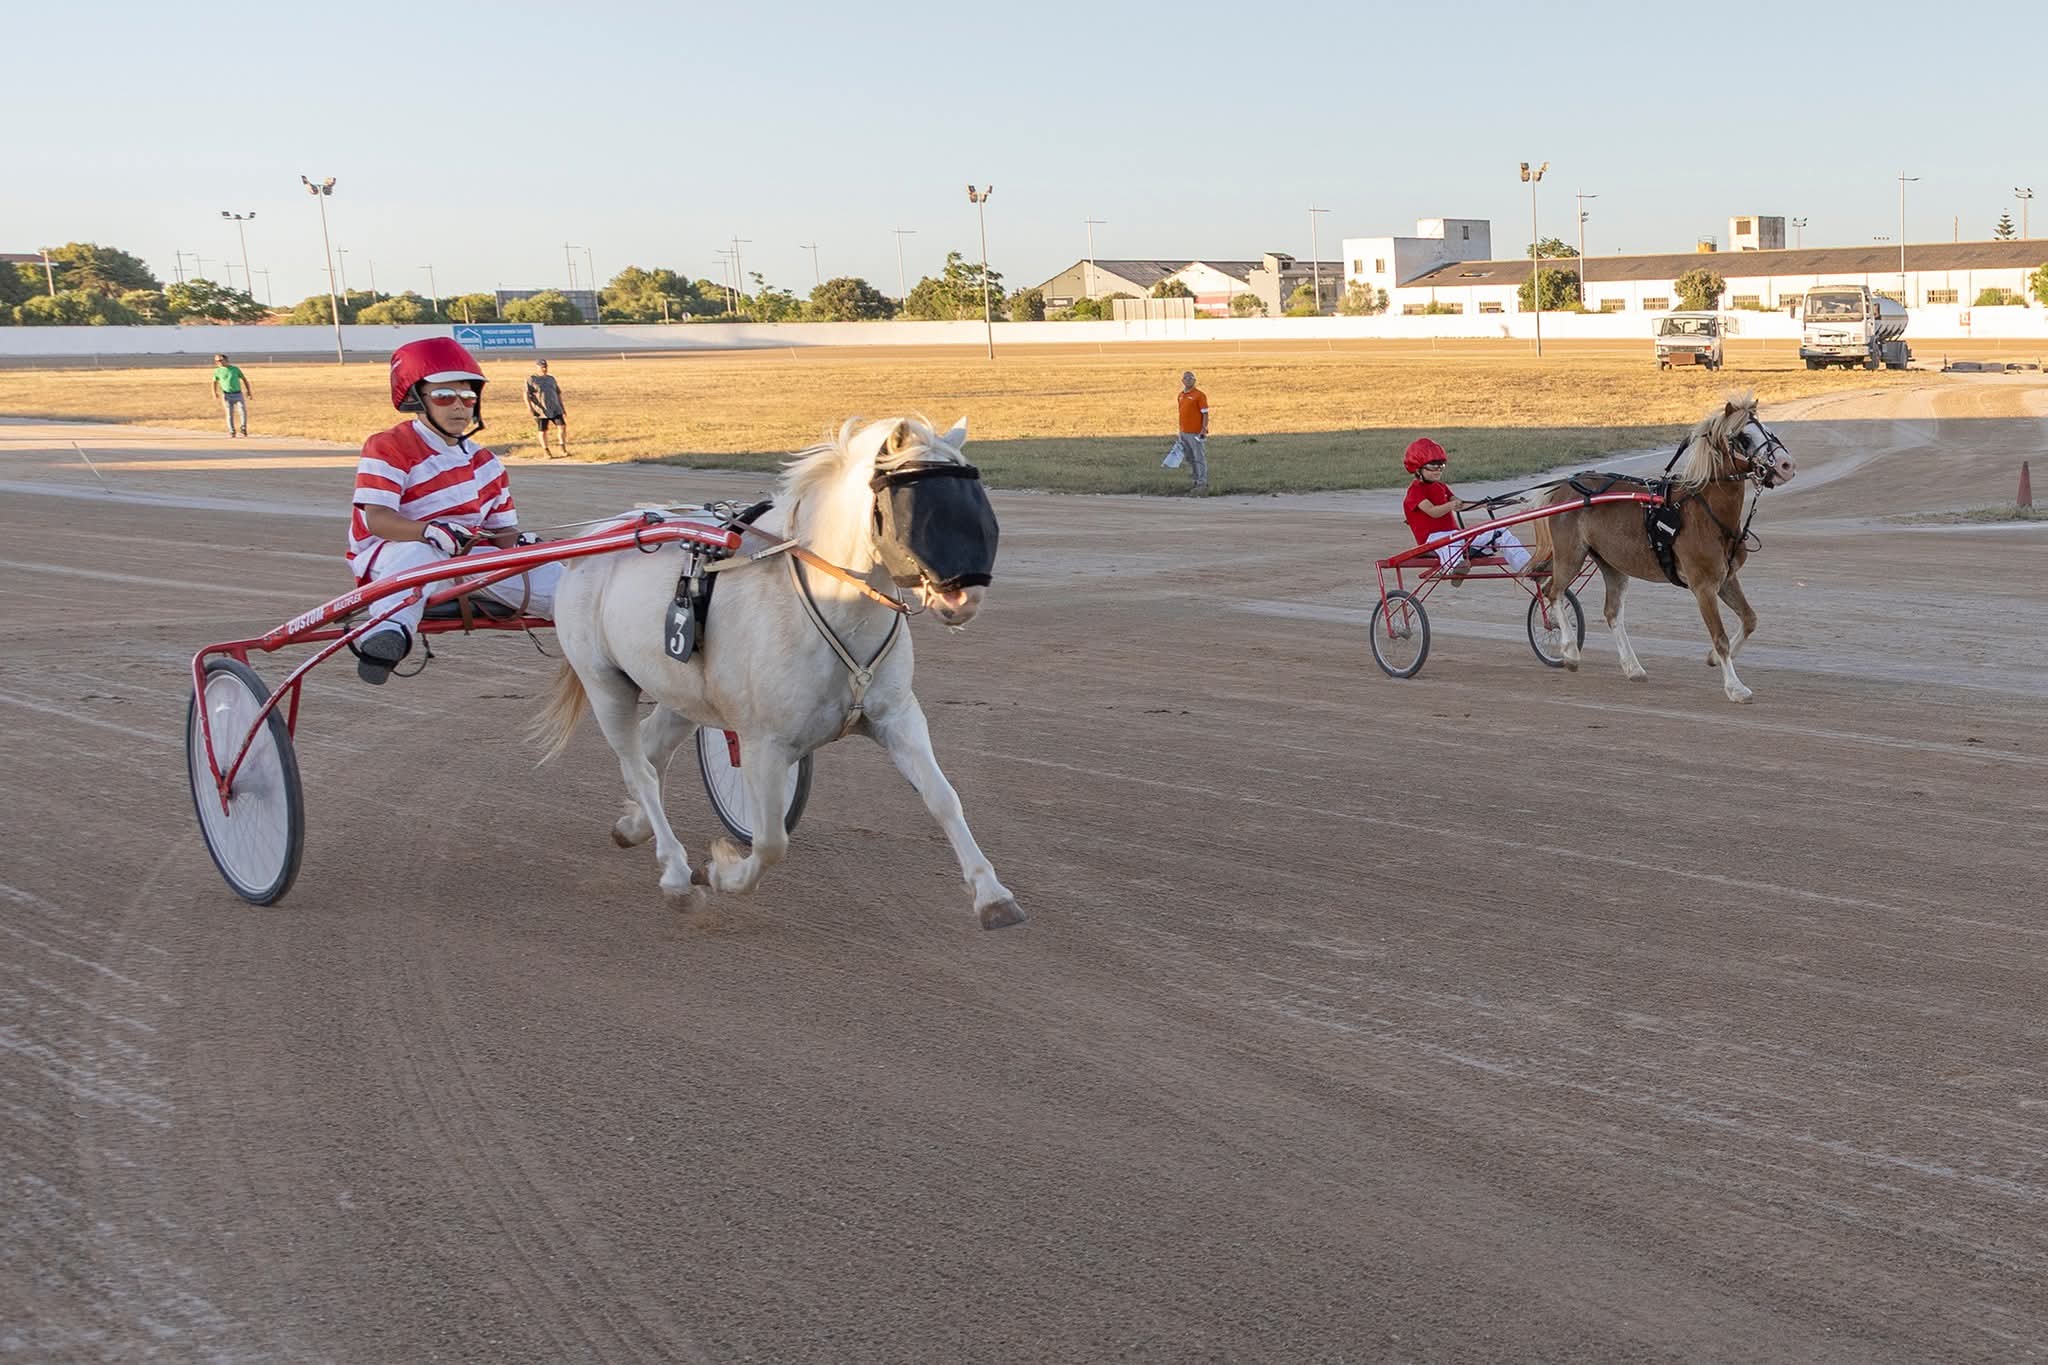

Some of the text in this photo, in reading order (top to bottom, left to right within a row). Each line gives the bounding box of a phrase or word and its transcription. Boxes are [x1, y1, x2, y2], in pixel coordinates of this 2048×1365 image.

[1656, 520, 1676, 536] 1
[287, 607, 323, 634] CUSTOM
[670, 612, 687, 655] 3
